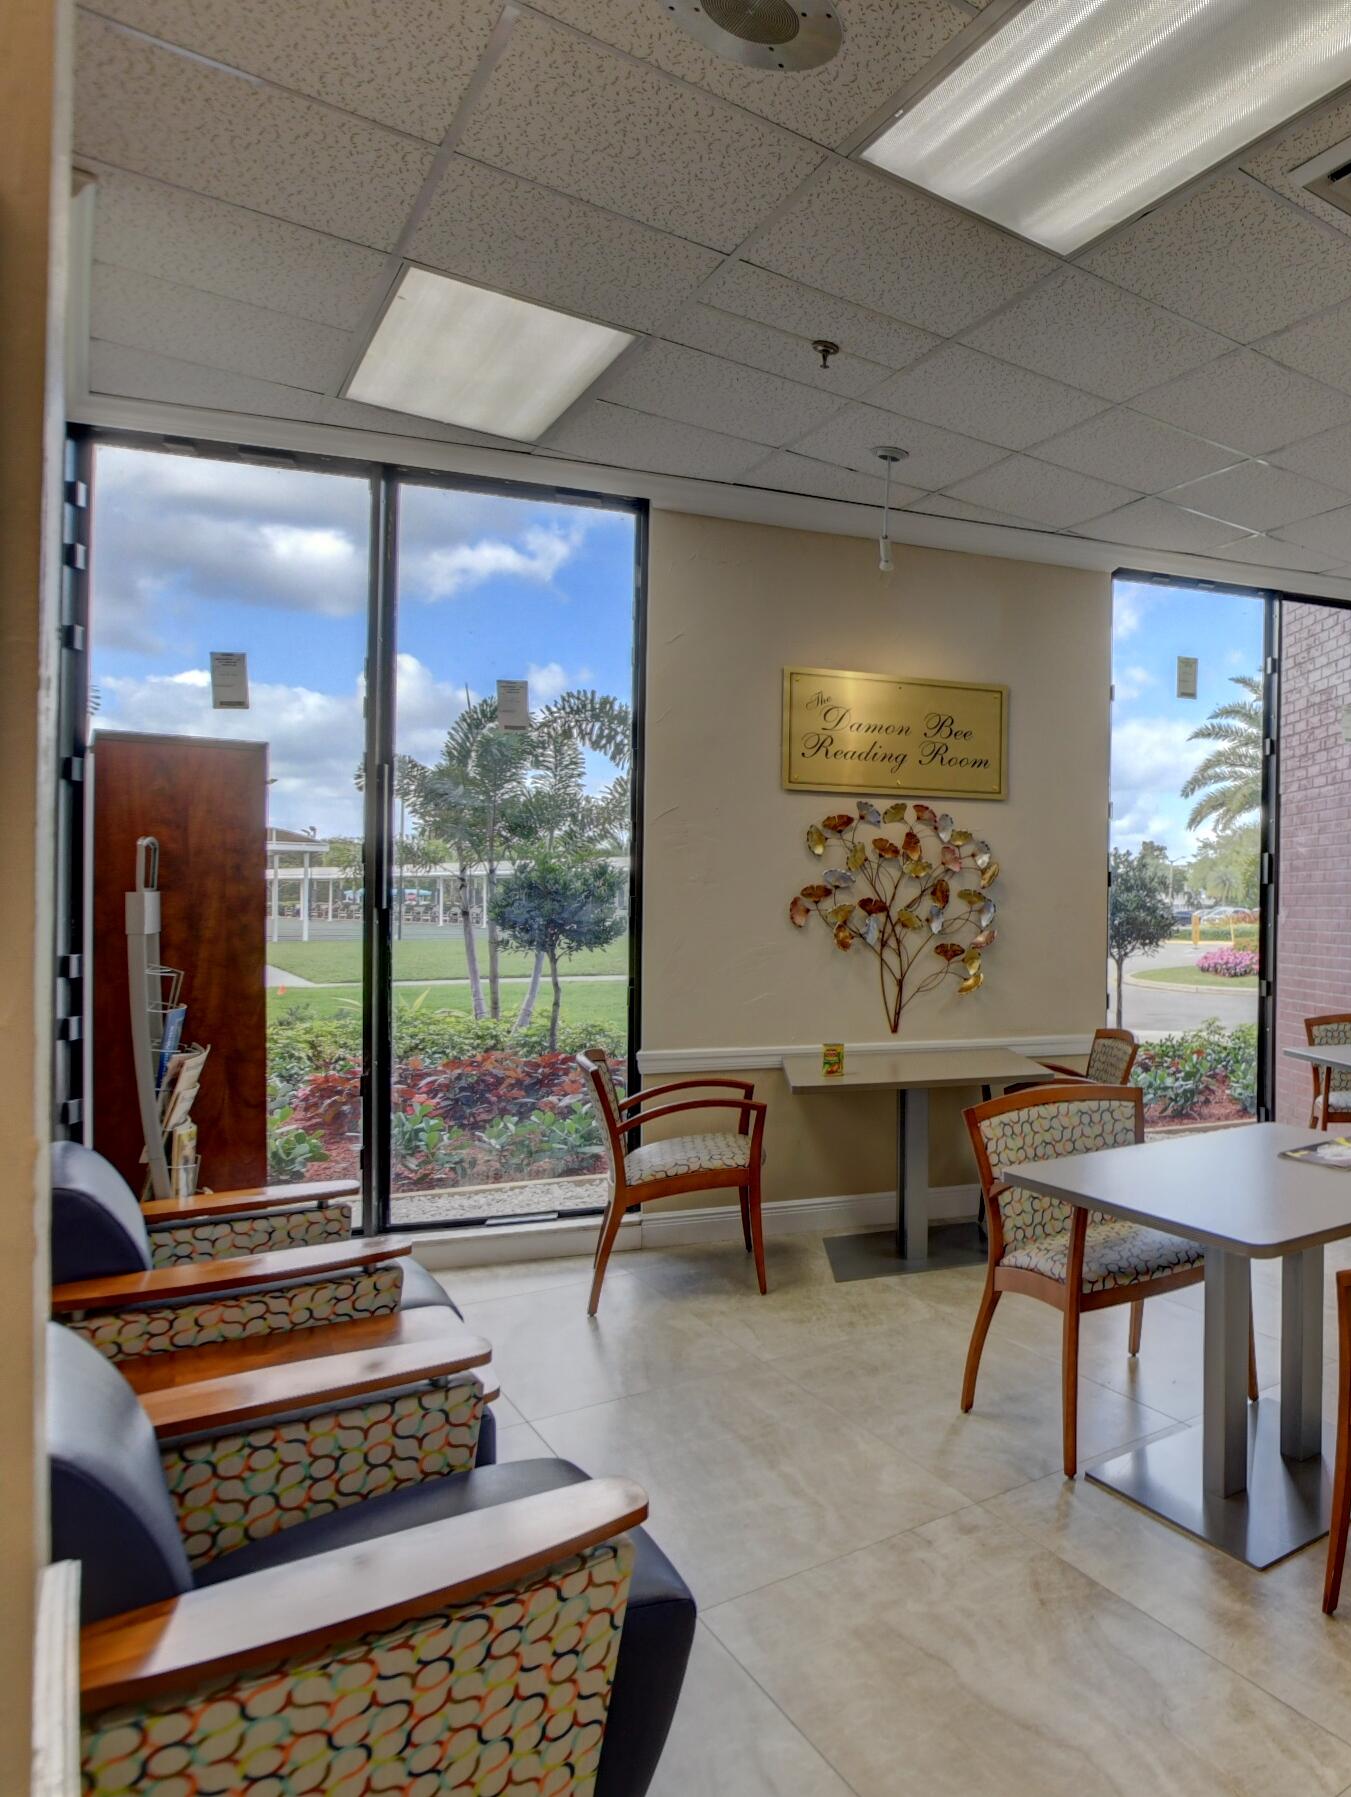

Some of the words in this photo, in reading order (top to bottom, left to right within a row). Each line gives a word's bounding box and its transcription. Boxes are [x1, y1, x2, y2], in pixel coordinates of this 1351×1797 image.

[805, 690, 832, 710] The
[821, 704, 912, 738] Damon
[923, 712, 975, 742] Bee
[801, 732, 908, 774] Reading
[918, 739, 991, 770] Room
